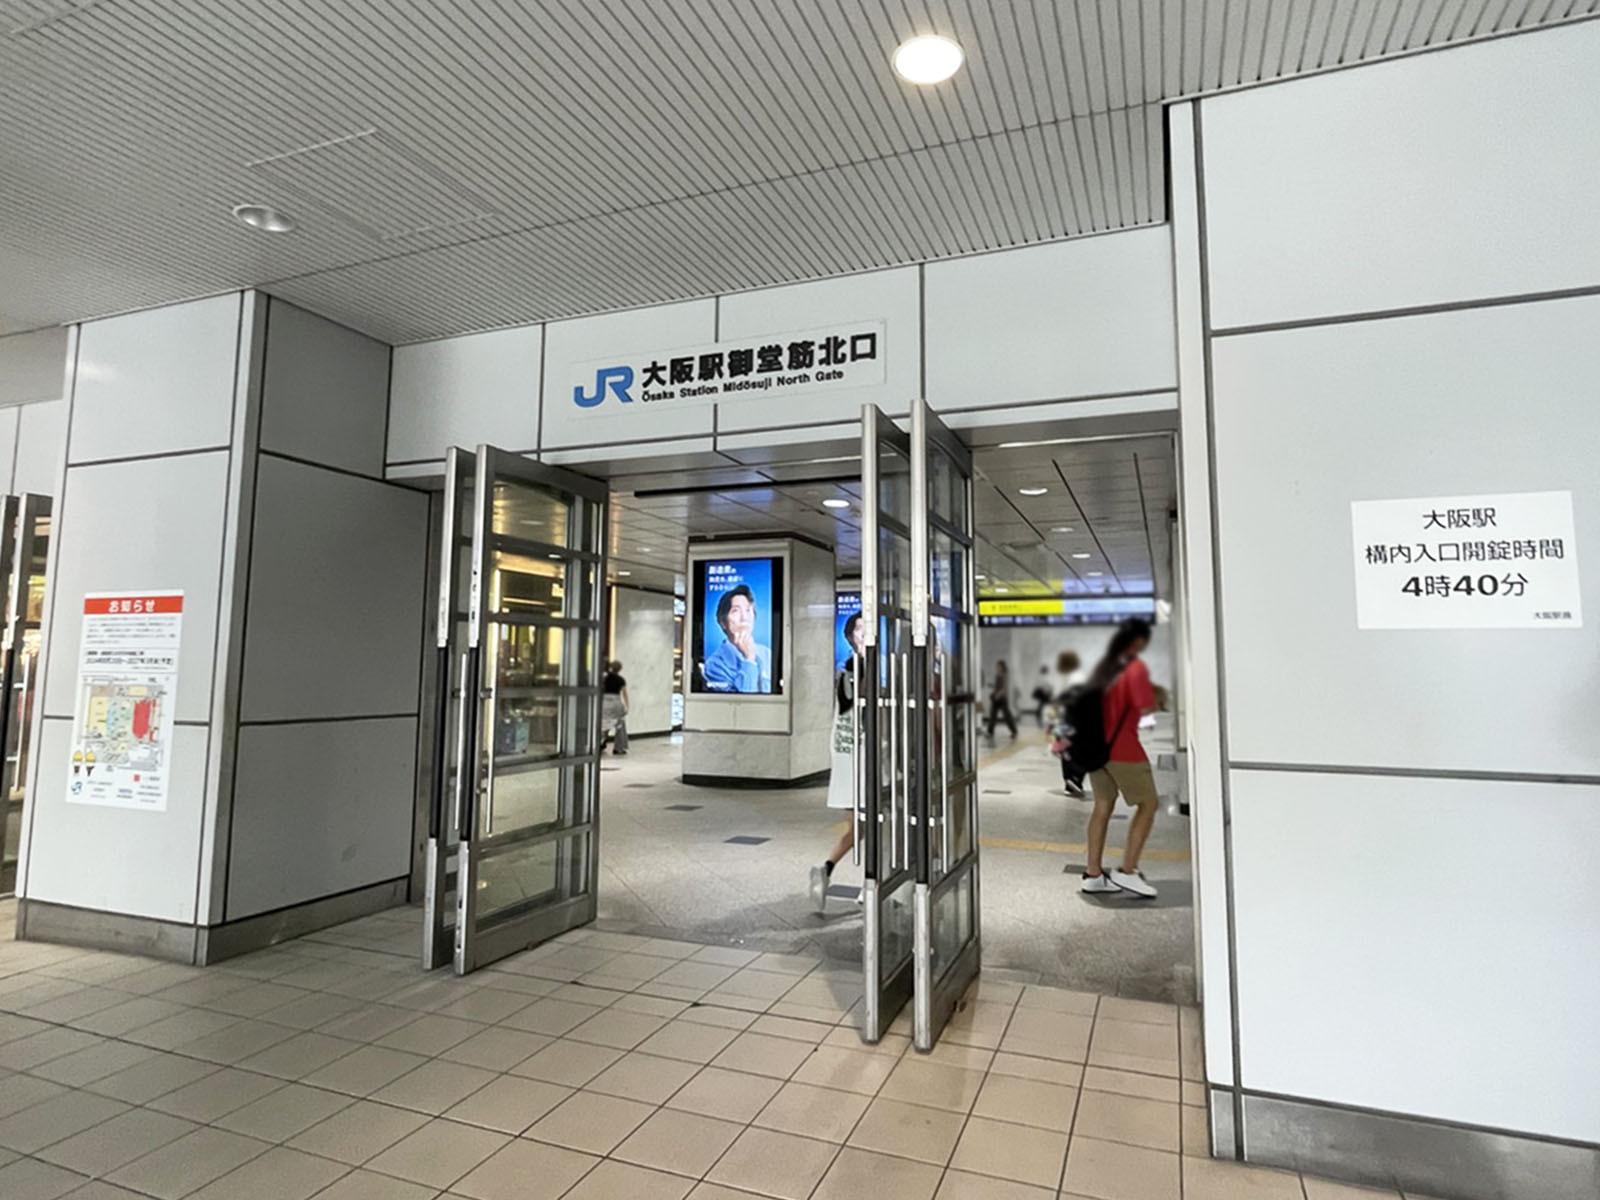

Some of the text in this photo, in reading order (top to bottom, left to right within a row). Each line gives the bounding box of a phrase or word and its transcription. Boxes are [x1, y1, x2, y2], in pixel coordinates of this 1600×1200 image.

[641, 332, 877, 388] 大阪駅御堂筋北口
[573, 365, 634, 408] JR
[679, 384, 718, 398] Station
[776, 372, 811, 387] North
[815, 369, 844, 382] Gate
[1422, 507, 1498, 530] 大阪駅
[1364, 538, 1565, 565] 構内入口開錠時間
[1401, 572, 1529, 598] 4時40分
[108, 600, 156, 613] お知らせ
